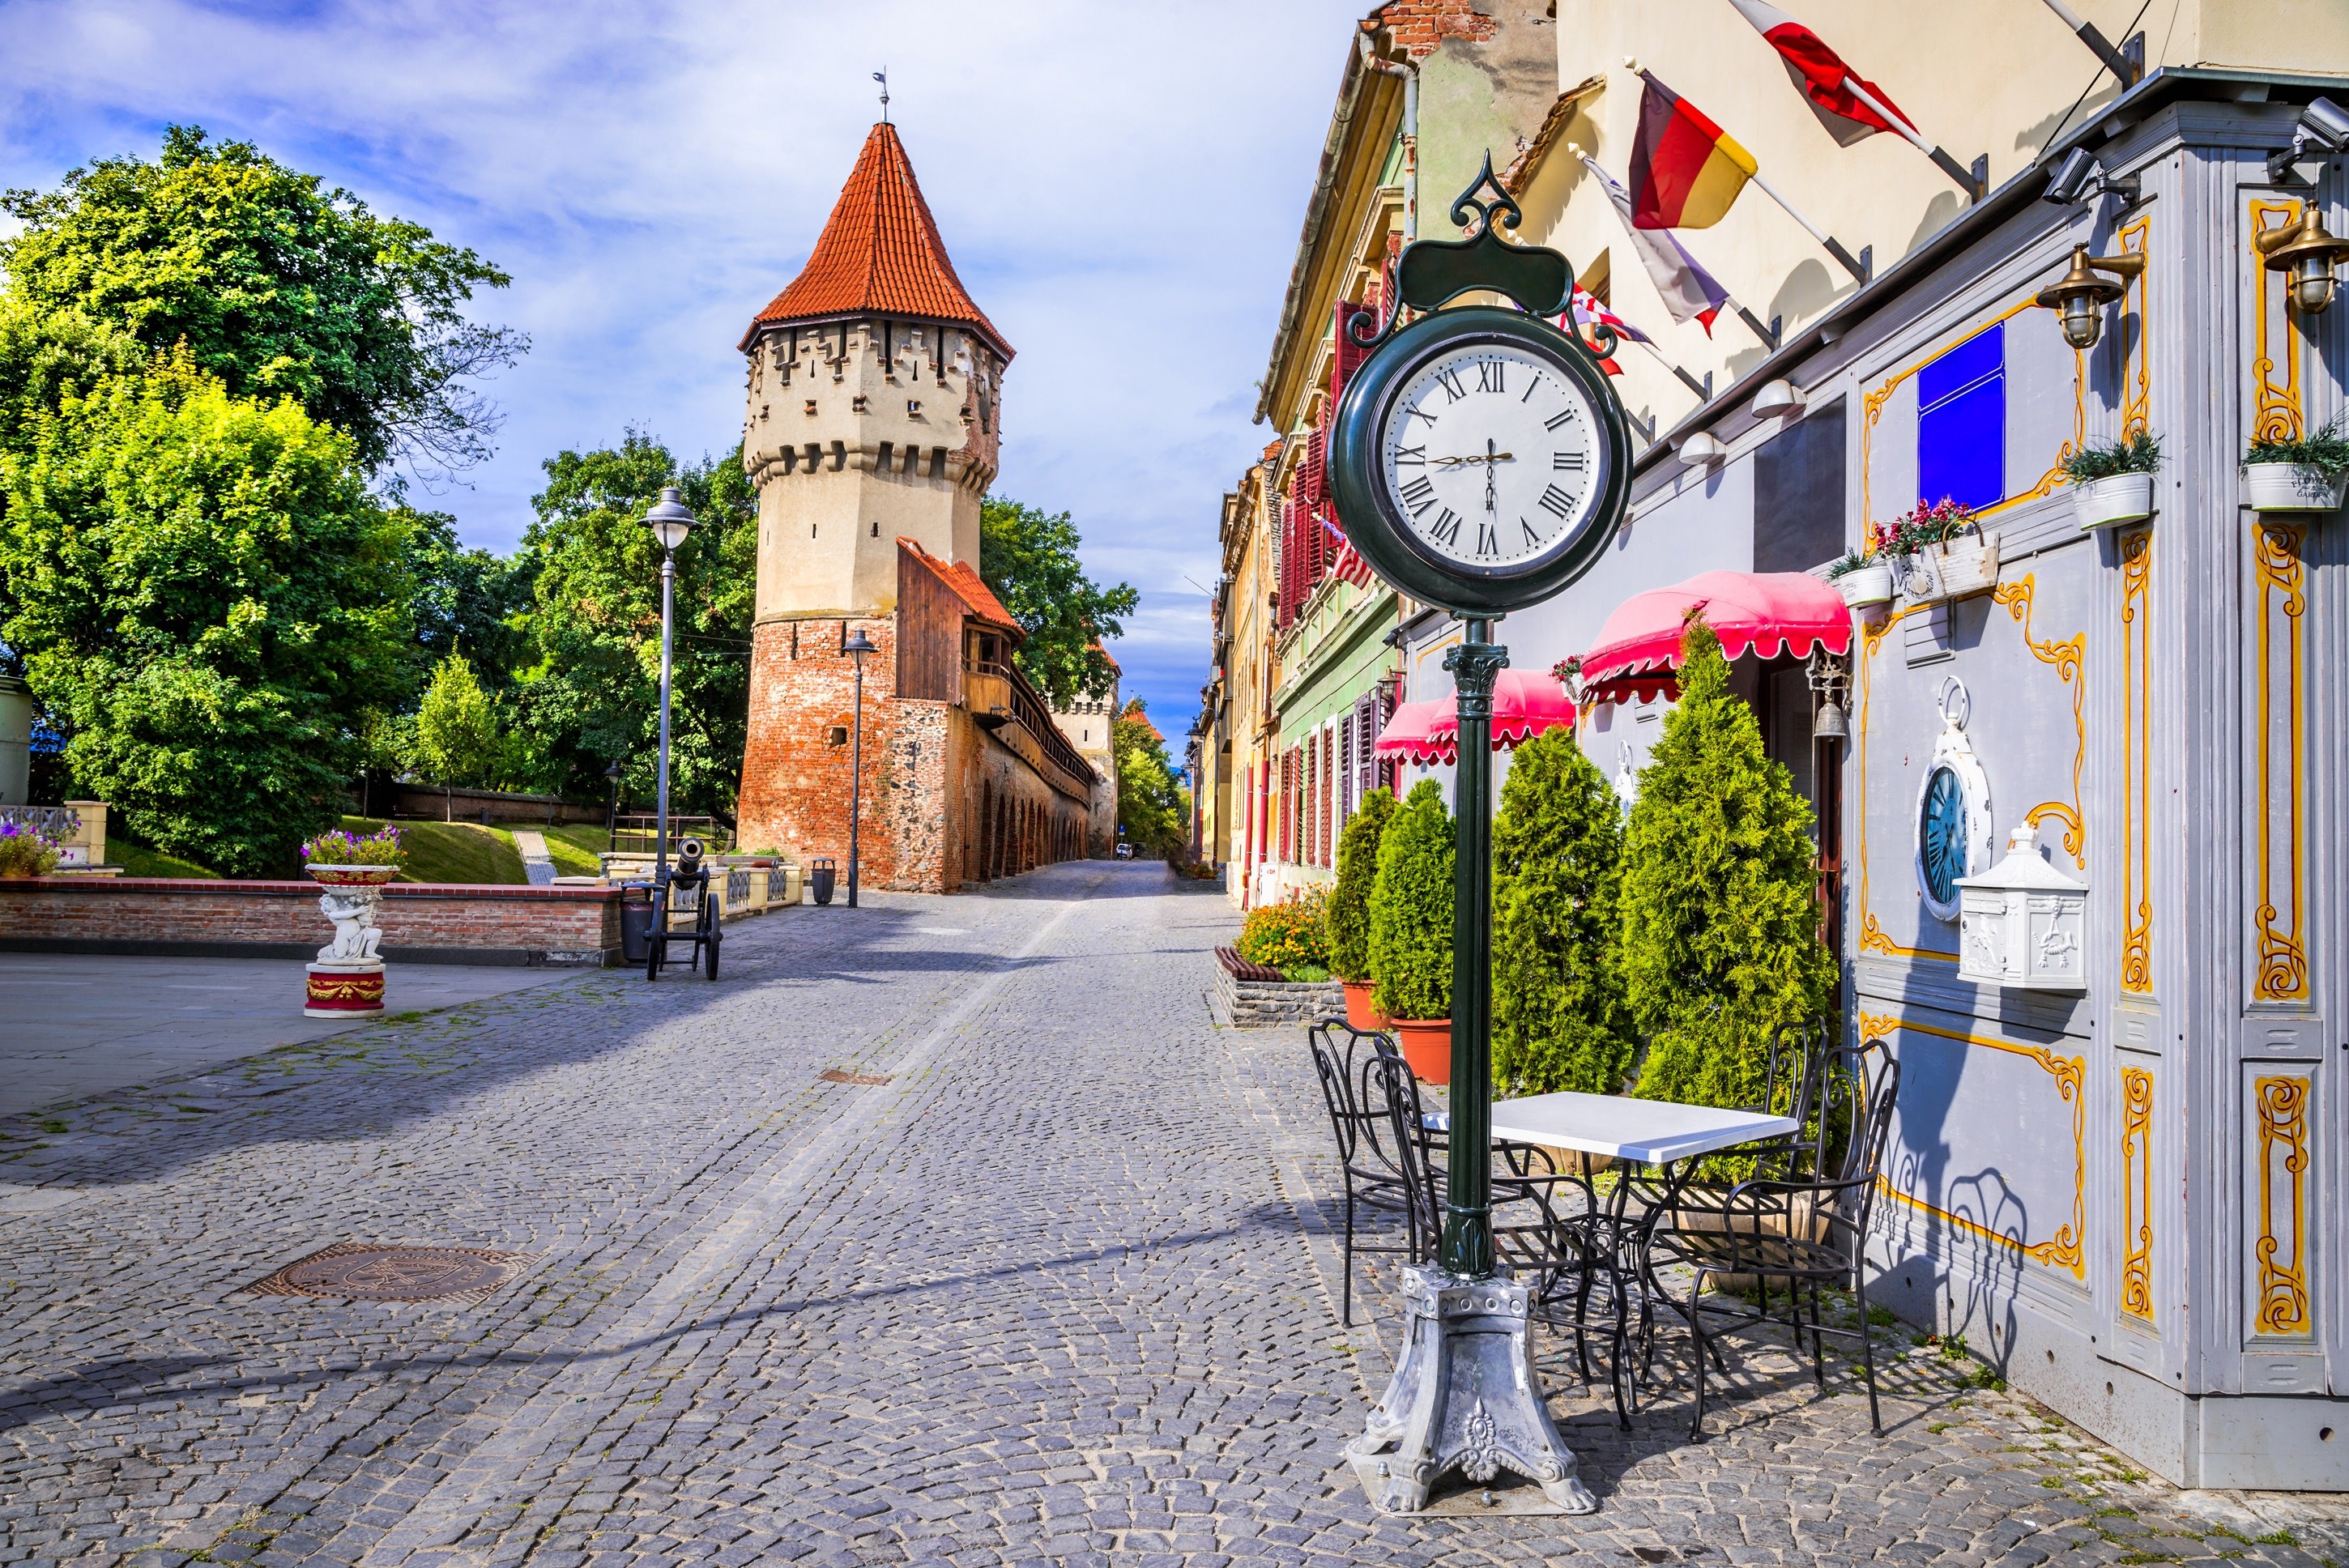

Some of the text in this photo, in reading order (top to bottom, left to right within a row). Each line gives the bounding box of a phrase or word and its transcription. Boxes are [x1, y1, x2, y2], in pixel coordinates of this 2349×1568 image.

[1435, 368, 1467, 404] XI
[1476, 361, 1504, 393] XII
[1521, 376, 1540, 403] I
[1405, 400, 1438, 428] X
[1544, 409, 1574, 432] II
[1394, 444, 1426, 467] IX
[1553, 451, 1584, 471] III
[1398, 475, 1439, 519] VIII
[2291, 477, 2337, 489] FLOWERS
[1537, 483, 1575, 519] IIII
[1429, 507, 1462, 547] VII
[1476, 523, 1498, 554] VI
[1520, 515, 1540, 547] V
